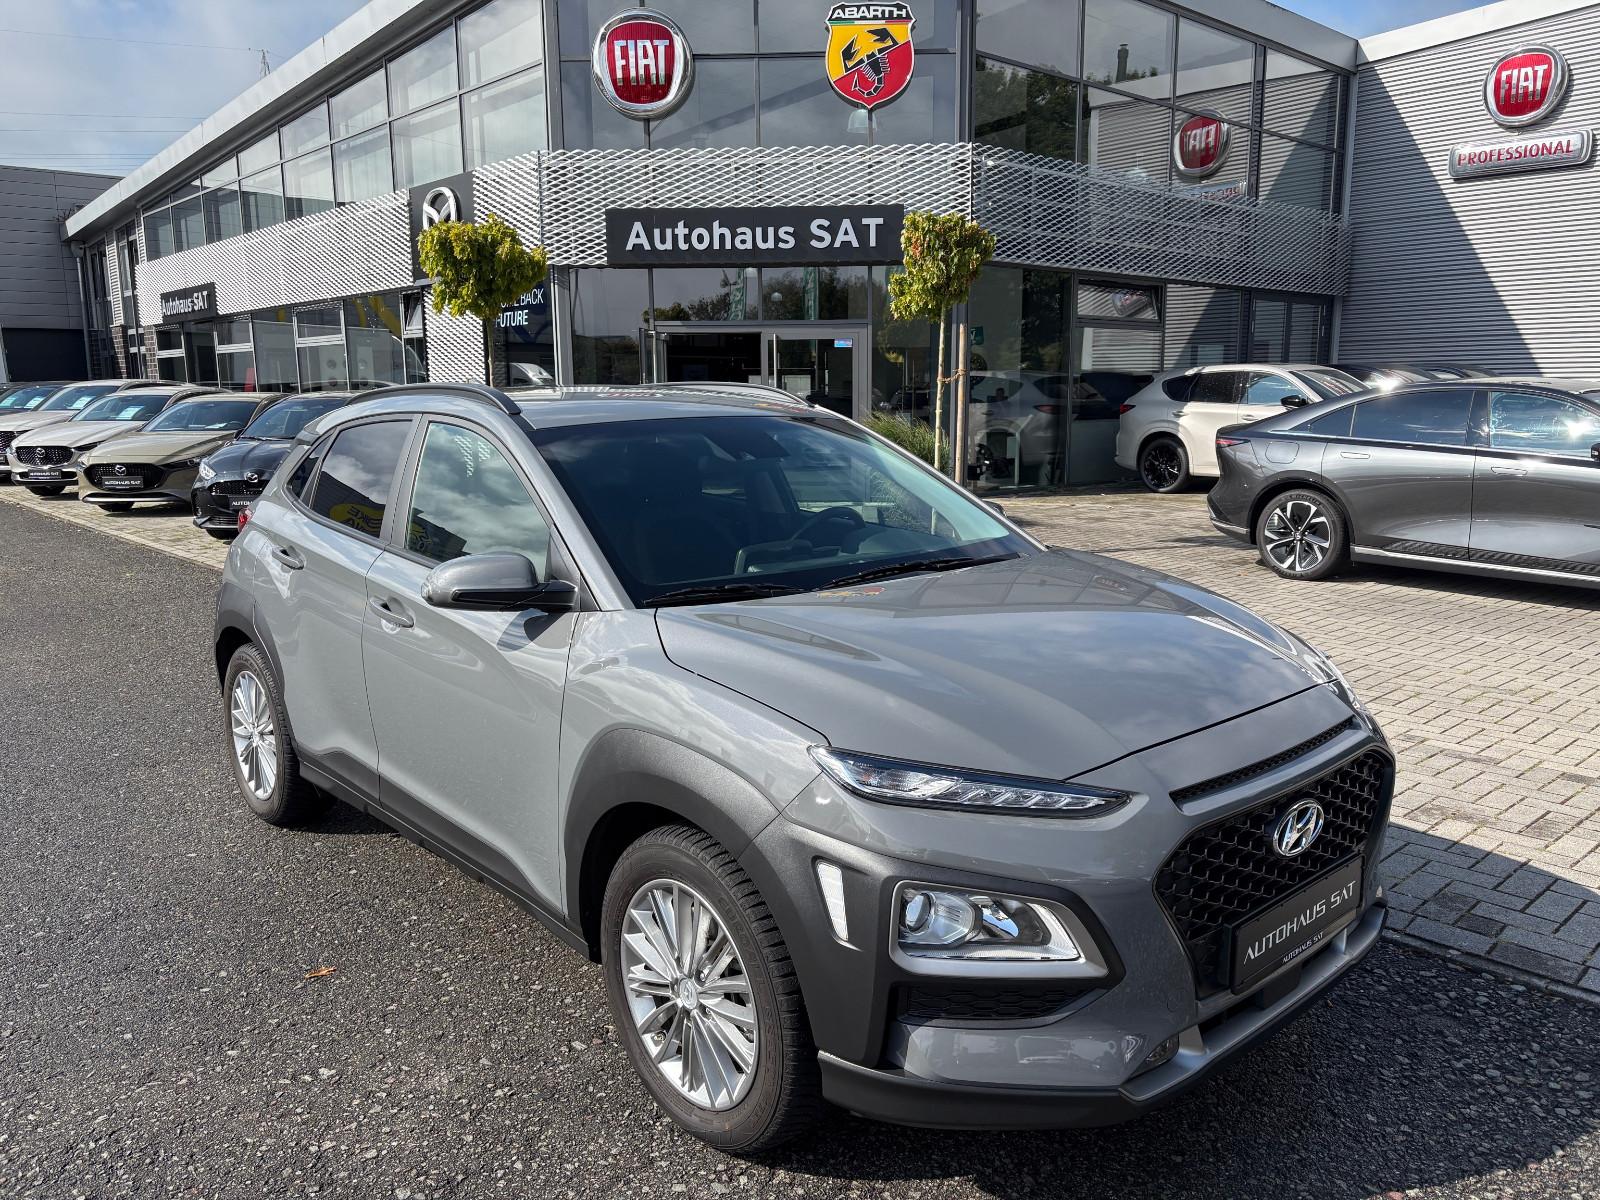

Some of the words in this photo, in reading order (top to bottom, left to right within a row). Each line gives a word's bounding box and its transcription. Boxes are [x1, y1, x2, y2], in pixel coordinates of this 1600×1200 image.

[831, 6, 907, 19] ABARTH
[613, 39, 670, 86] FIAT
[1499, 64, 1548, 105] FIAT
[1457, 140, 1574, 167] PROFESSIONAL
[625, 219, 796, 251] Autohaus
[809, 217, 884, 249] SAT
[161, 296, 192, 316] Autohaus
[193, 290, 208, 311] SAT
[520, 288, 544, 306] BACK
[1243, 899, 1327, 966] AUTOHAUS
[1330, 880, 1357, 909] SAT
[1282, 940, 1312, 964] AUTOHAUS
[1313, 931, 1325, 944] SAT
